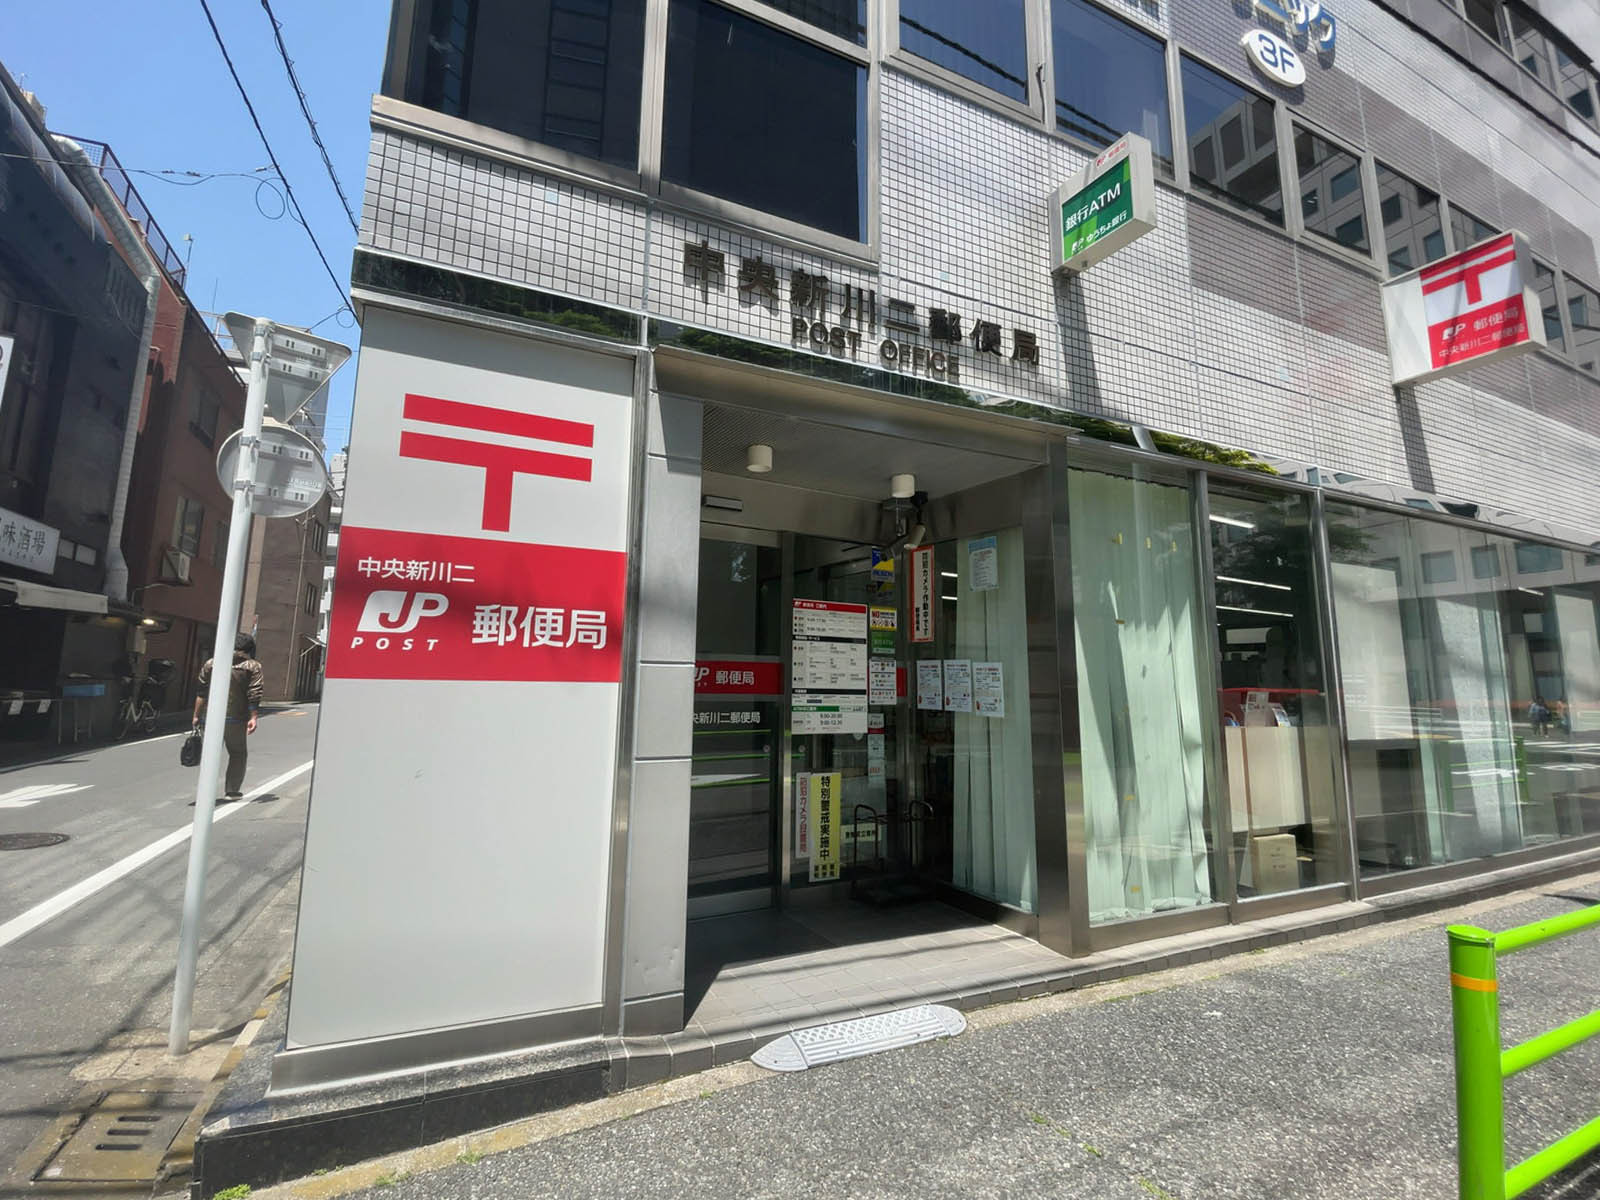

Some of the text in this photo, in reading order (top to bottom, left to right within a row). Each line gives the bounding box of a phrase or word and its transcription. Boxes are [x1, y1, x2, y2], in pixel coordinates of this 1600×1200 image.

[1258, 33, 1295, 73] 3F
[1065, 181, 1121, 232] 銀行ATM
[1086, 209, 1128, 242] ゆうちょ銀行
[683, 239, 1040, 367] 中央新川二郵便局
[1472, 306, 1519, 331] 郵便局
[792, 316, 960, 381] POST OFFICE
[1437, 322, 1526, 358] 中央新川二郵便局
[0, 517, 46, 556] 味酒場
[357, 556, 475, 584] 中央新川二
[350, 636, 438, 651] POST
[472, 603, 607, 650] 郵便局
[716, 670, 754, 686] 郵便局
